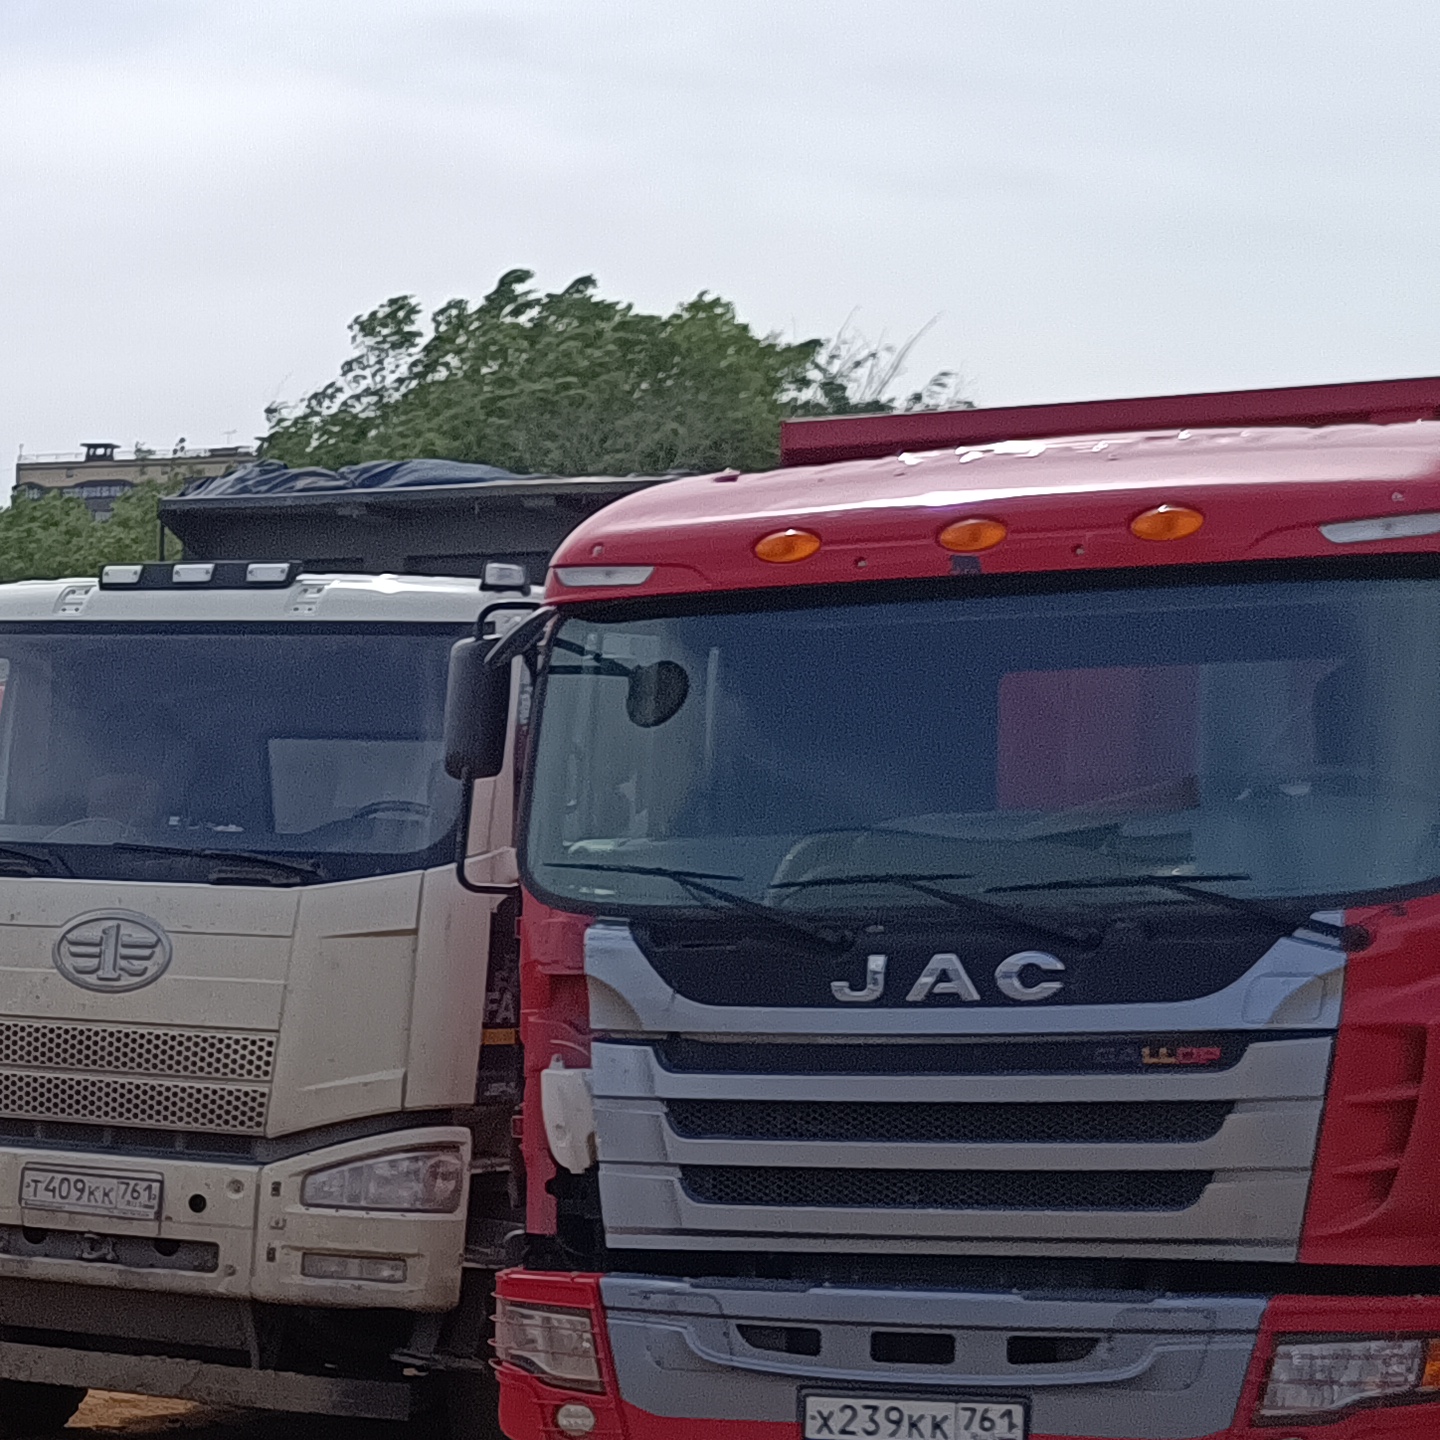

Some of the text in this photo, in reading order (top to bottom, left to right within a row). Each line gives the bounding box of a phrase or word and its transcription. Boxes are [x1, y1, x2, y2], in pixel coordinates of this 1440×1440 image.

[830, 951, 1066, 1002] JAC
[119, 1181, 153, 1203] 761
[960, 1407, 1018, 1433] 761
